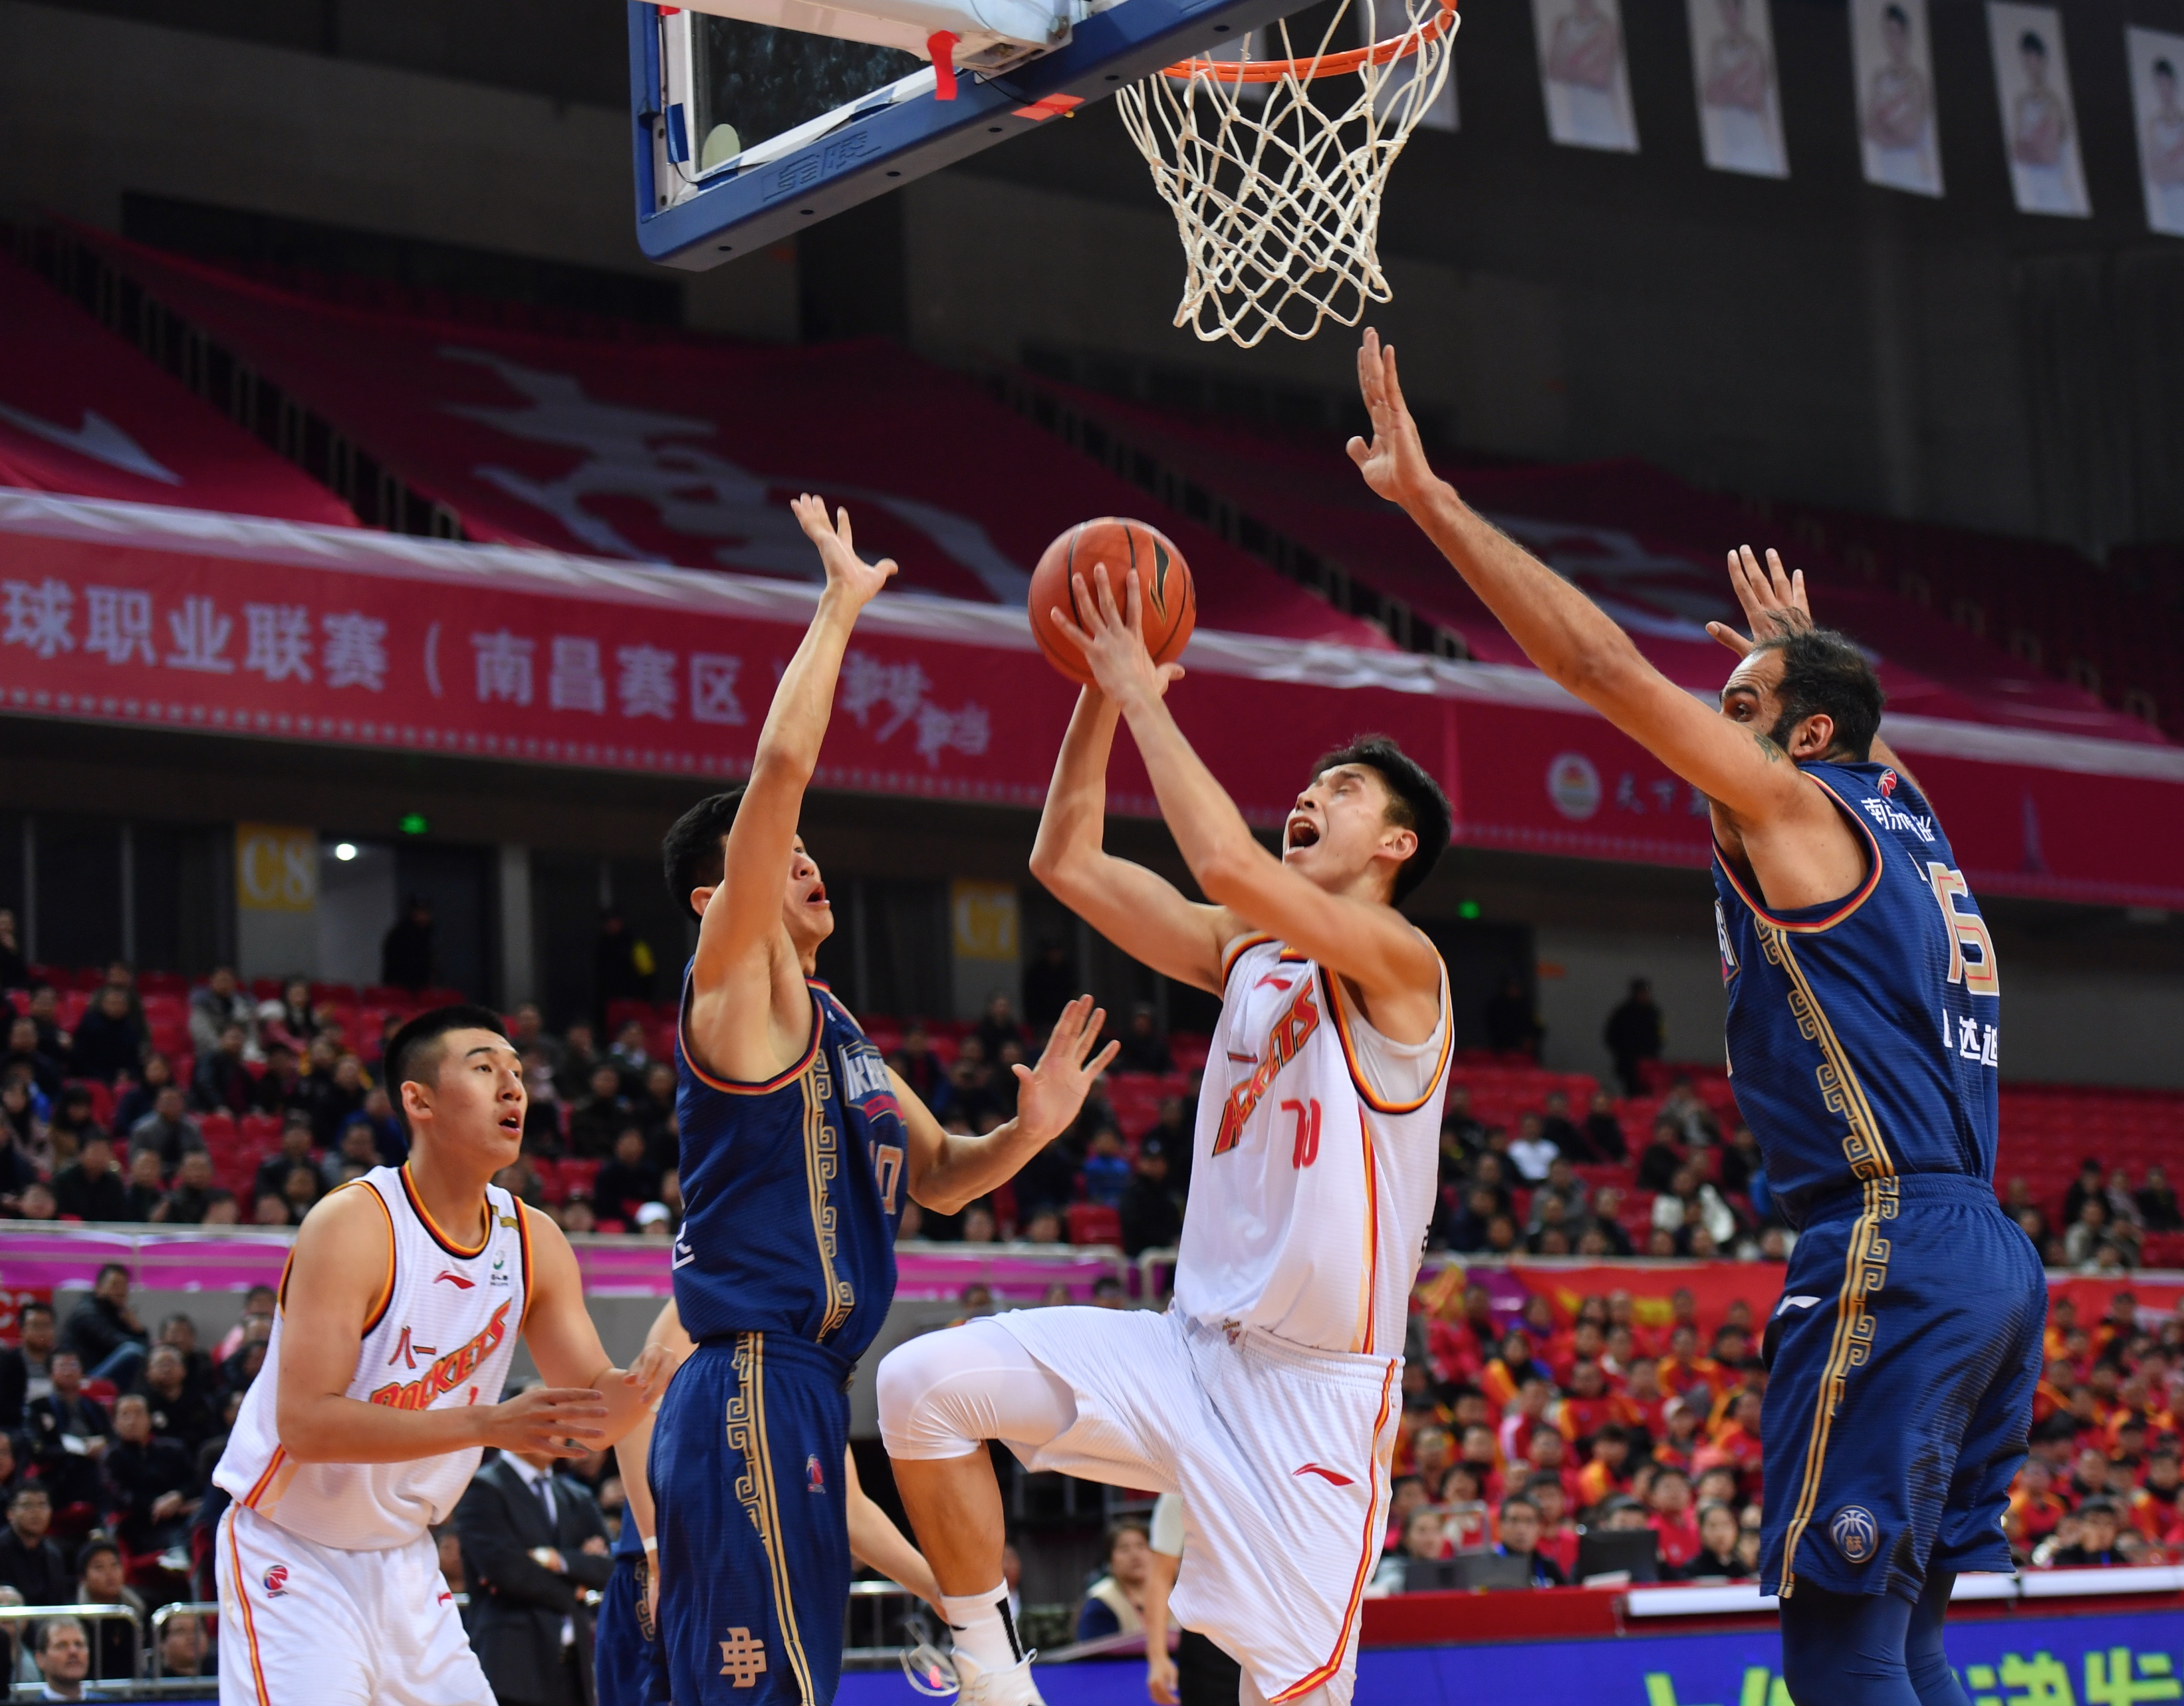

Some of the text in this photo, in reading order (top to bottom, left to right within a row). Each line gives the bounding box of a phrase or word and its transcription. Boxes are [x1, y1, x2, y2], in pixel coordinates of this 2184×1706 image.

[1, 576, 747, 727] 球职业联赛（南昌赛区
[241, 836, 317, 903] C8
[1211, 975, 1320, 1158] RCKETS
[370, 1296, 513, 1411] ROCKETS
[388, 1325, 437, 1369] 八一
